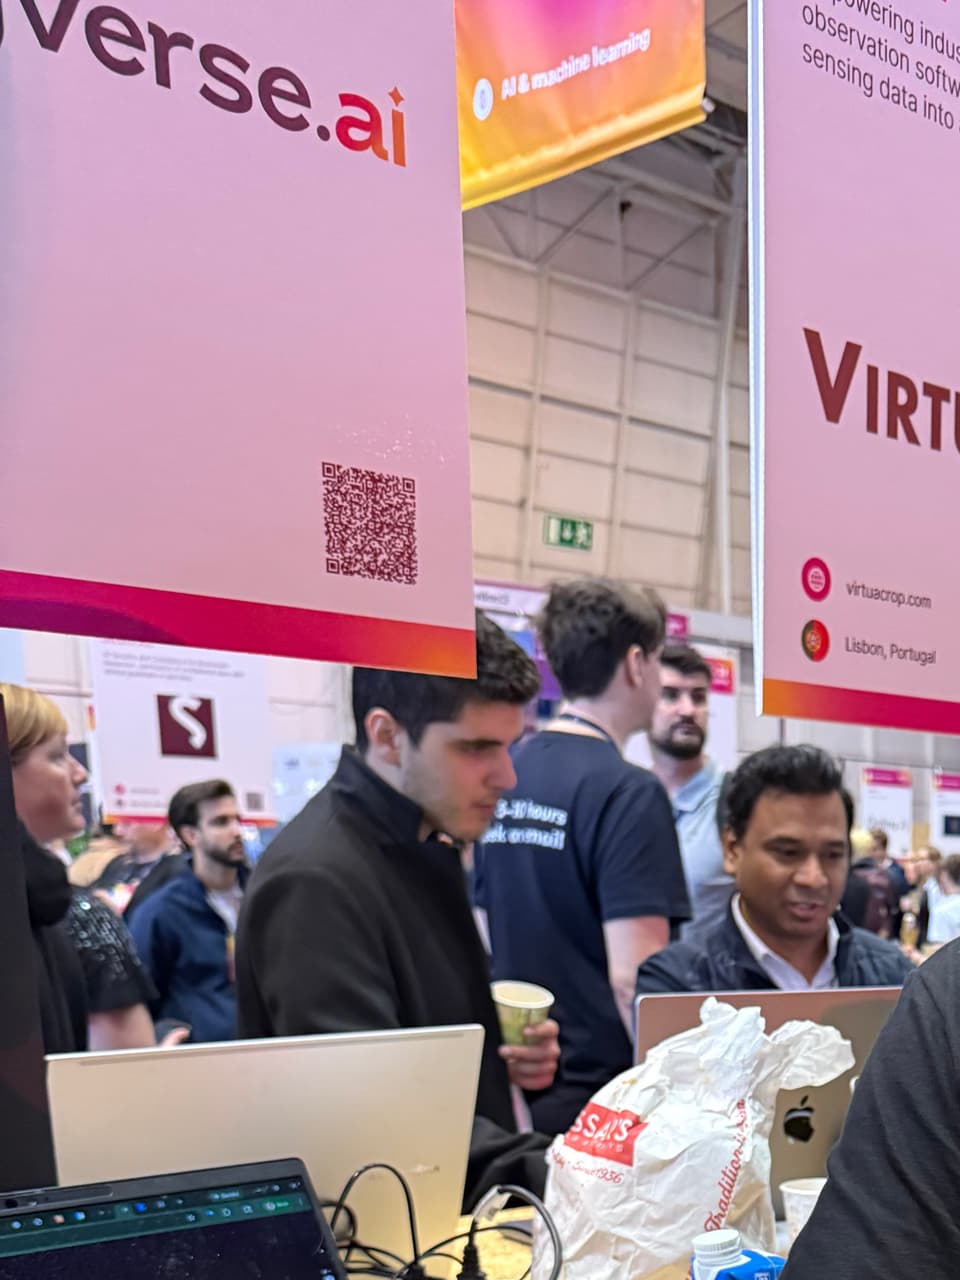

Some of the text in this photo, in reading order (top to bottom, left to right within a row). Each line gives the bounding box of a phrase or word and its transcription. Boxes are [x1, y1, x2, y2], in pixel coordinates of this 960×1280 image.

[502, 27, 651, 101] AI & machine learning
[802, 4, 910, 74] observation
[0, 0, 406, 168] verse.ai
[802, 42, 873, 98] sensing
[879, 77, 917, 114] data
[922, 94, 954, 130] into
[846, 581, 932, 608] virtuacrop.com
[845, 637, 937, 666] Lisbon, Portugal
[703, 1148, 744, 1232] Tradition
